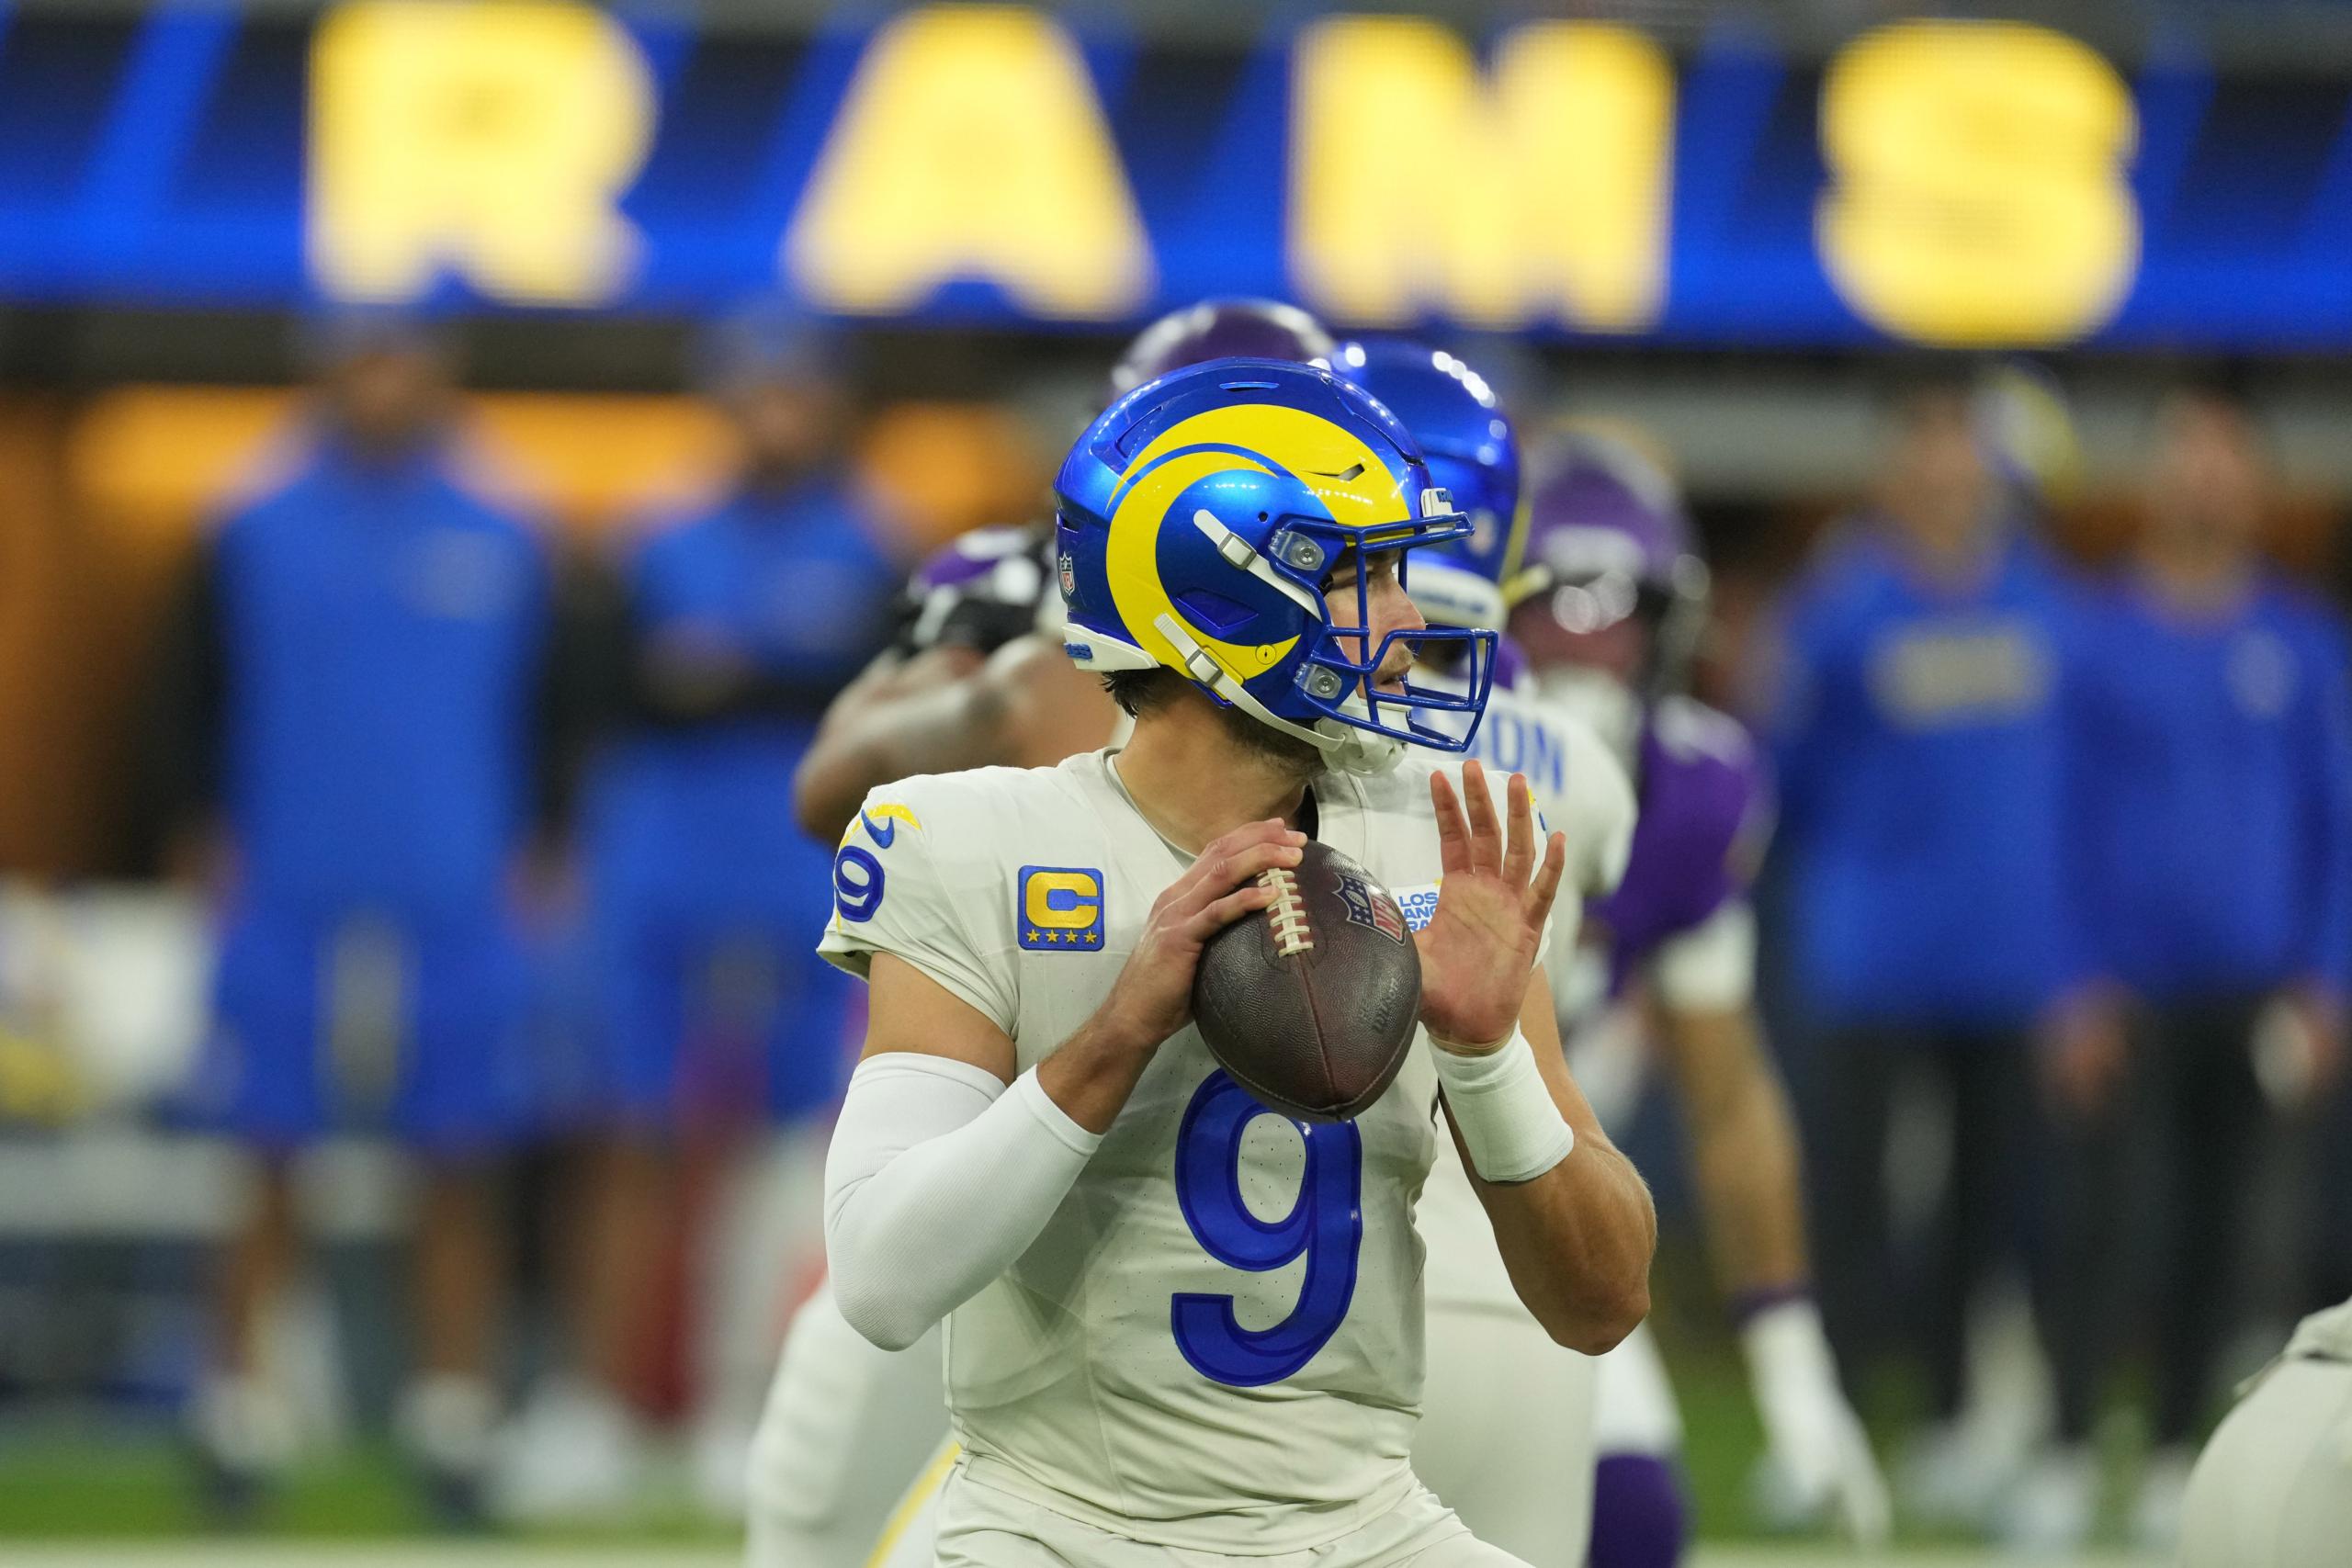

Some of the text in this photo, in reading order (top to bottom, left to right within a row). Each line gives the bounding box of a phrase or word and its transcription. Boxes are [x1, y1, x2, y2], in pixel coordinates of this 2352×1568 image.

[303, 0, 2141, 349] RAMS
[835, 845, 885, 922] 9
[1025, 872, 1098, 929] C
[1398, 892, 1439, 907] LOS
[1171, 1067, 1363, 1388] 9
